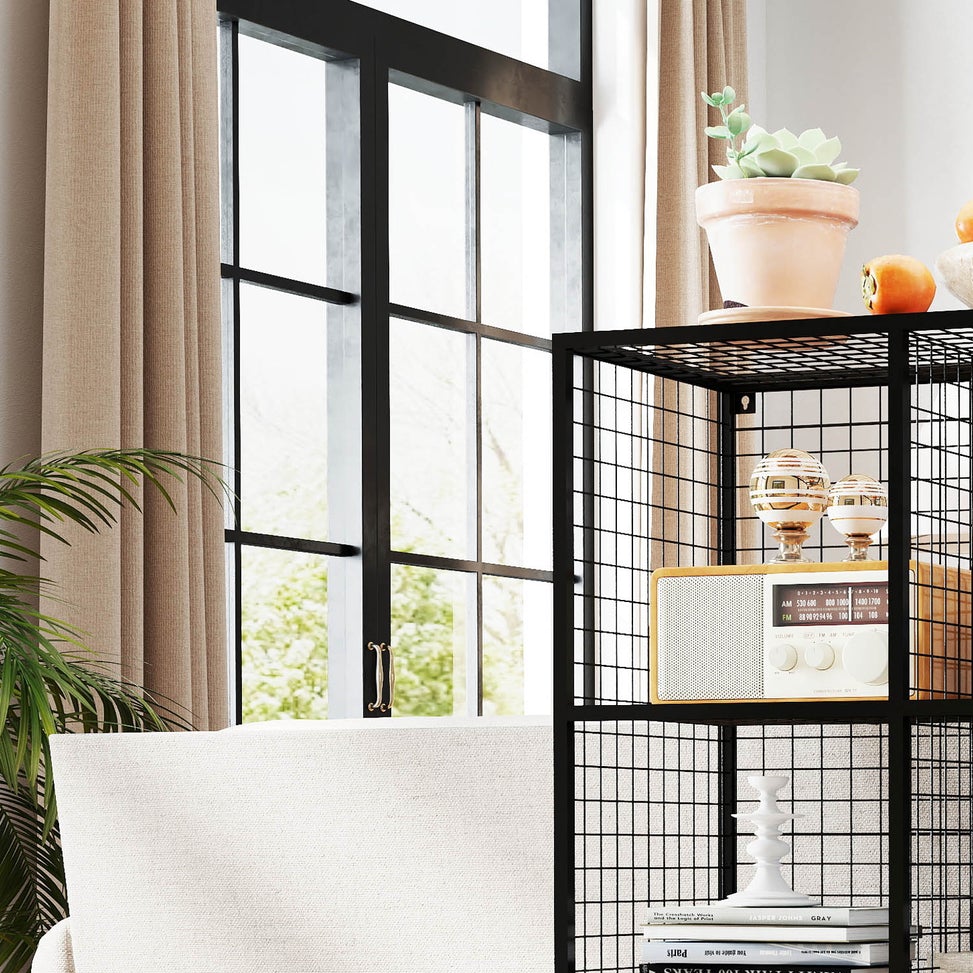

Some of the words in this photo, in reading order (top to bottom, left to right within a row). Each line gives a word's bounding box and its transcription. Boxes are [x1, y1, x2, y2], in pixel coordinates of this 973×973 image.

[781, 600, 793, 608] AM
[796, 599, 806, 608] 530
[868, 597, 881, 605] 1700
[666, 949, 688, 958] Paris
